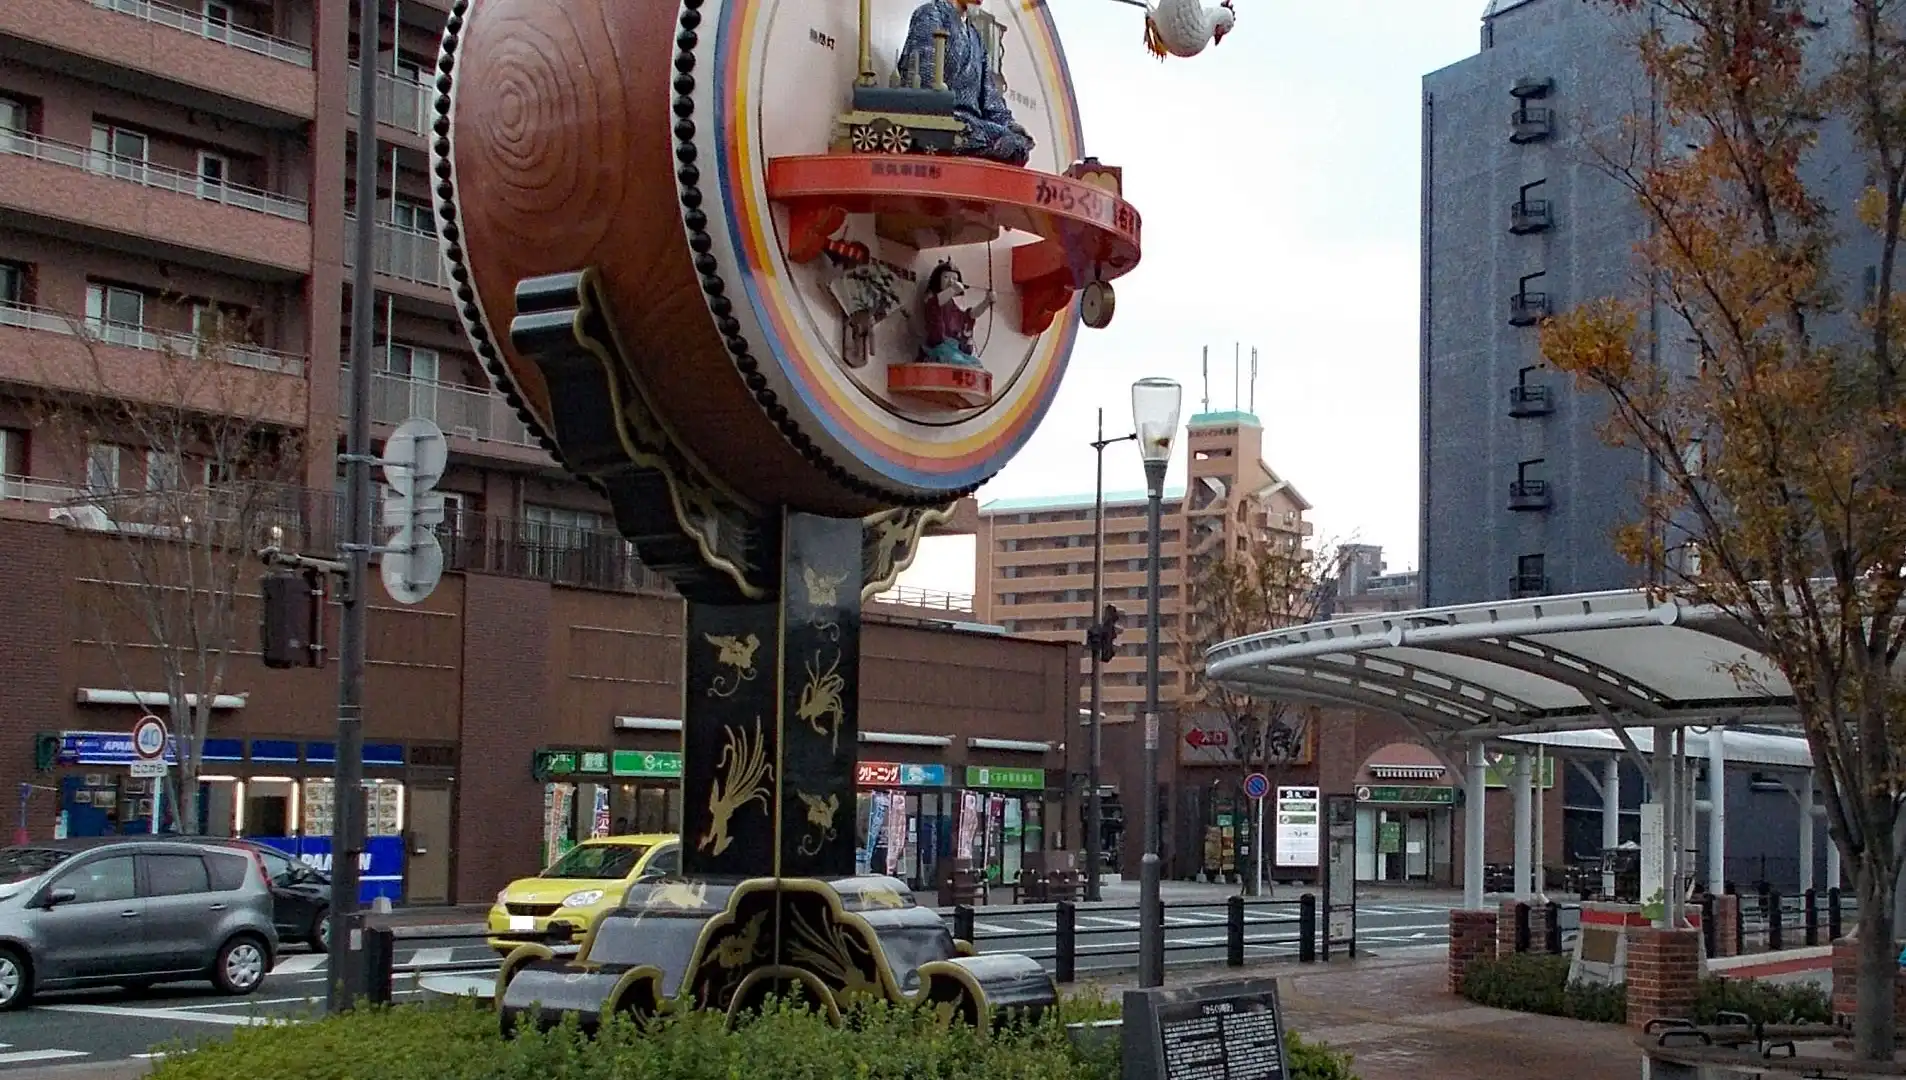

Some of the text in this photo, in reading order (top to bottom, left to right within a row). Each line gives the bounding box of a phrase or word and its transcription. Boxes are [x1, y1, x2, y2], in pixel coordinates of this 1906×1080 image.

[141, 728, 159, 746] 40
[858, 766, 898, 782] クリーニング
